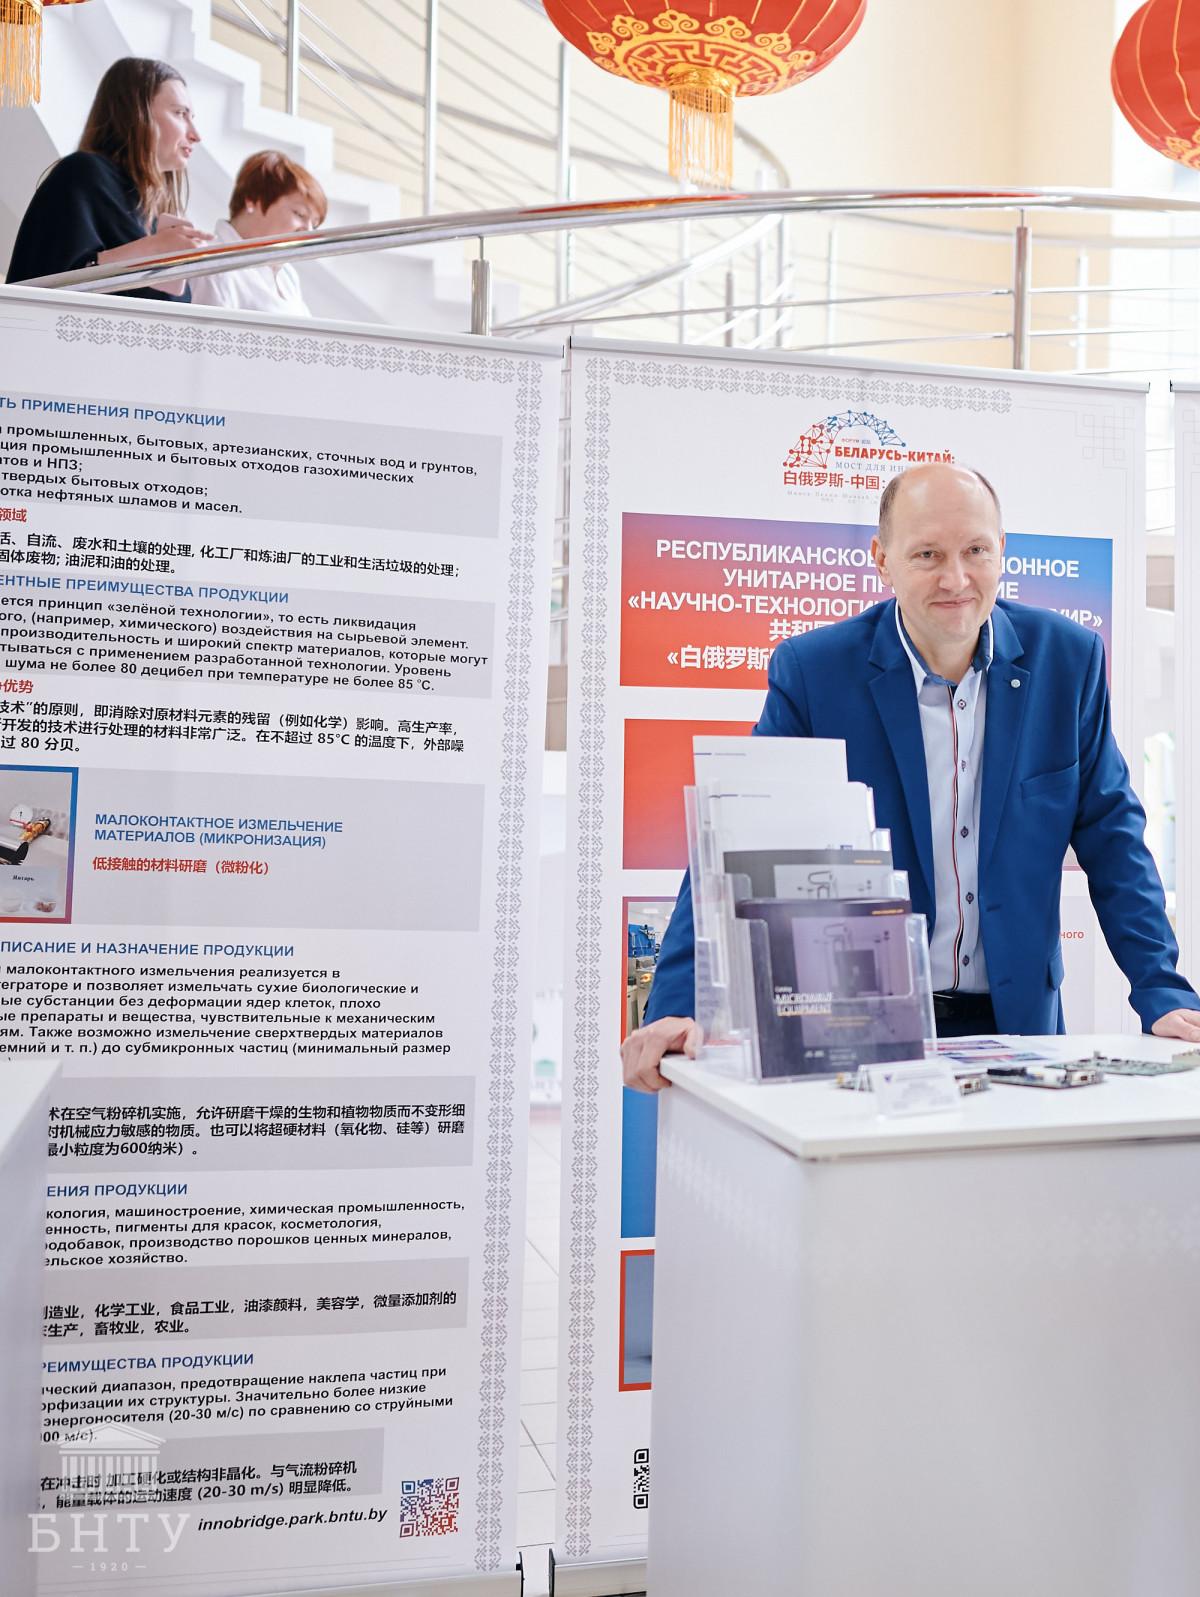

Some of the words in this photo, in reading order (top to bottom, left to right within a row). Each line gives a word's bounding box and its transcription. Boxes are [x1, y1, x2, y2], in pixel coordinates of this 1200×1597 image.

[20, 398, 129, 419] ПРИМЕНЕНИЯ
[132, 408, 226, 427] ПРОДУКЦИИ
[6, 426, 132, 446] промышленных,
[135, 434, 208, 452] бытовых,
[211, 443, 312, 461] артезианских,
[315, 452, 376, 466] сточных
[379, 458, 405, 470] вод
[408, 460, 417, 469] и
[420, 462, 477, 476] грунтов,
[834, 446, 956, 464] БЕЛАРУСЬ-КИТАЙ:
[31, 443, 153, 462] промышленных
[156, 453, 166, 463] и
[169, 452, 237, 468] бытовых
[240, 460, 300, 474] отходов
[302, 465, 414, 484] газохимических
[835, 461, 863, 471] МОСТ
[0, 507, 28, 522] 领域
[722, 568, 857, 592] УНИТАРНОЕ
[65, 578, 194, 598] ПРЕИМУЩЕСТВА
[197, 586, 289, 604] ПРОДУКЦИИ
[628, 591, 880, 618] «НАУЧНО-ТЕХНОЛОГИ
[667, 645, 774, 671] «白俄罗斯
[94, 813, 235, 829] МАЛОКОНТАКТНОЕ
[237, 818, 343, 833] ИЗМЕЛЬЧЕНИЕ
[93, 829, 195, 843] МАТЕРИАЛОВ
[198, 832, 326, 850] (МИКРОНИЗАЦИЯ)
[0, 941, 77, 954] ПИСАНИЕ
[80, 942, 92, 954] И
[95, 942, 199, 955] НАЗНАЧЕНИЕ
[202, 944, 294, 958] ПРОДУКЦИИ
[5, 965, 136, 976] малоконтактного
[138, 967, 235, 977] измельчения
[238, 968, 327, 981] реализуется
[331, 970, 340, 979] в
[93, 1183, 188, 1198] ПРОДУКЦИИ
[114, 1206, 245, 1219] машиностроение,
[248, 1205, 334, 1215] химическая
[337, 1201, 465, 1216] промышленность,
[107, 1252, 188, 1265] хозяйство.
[41, 1357, 157, 1373] ЕИМУЩЕСТВА
[160, 1353, 254, 1369] ПРОДУКЦИИ
[100, 1381, 176, 1394] диапазон,
[179, 1375, 305, 1392] предотвращение
[307, 1372, 366, 1384] наклепа
[369, 1369, 418, 1381] частиц
[420, 1368, 446, 1380] при
[196, 1507, 388, 1531] innobridge.park.bntu.by
